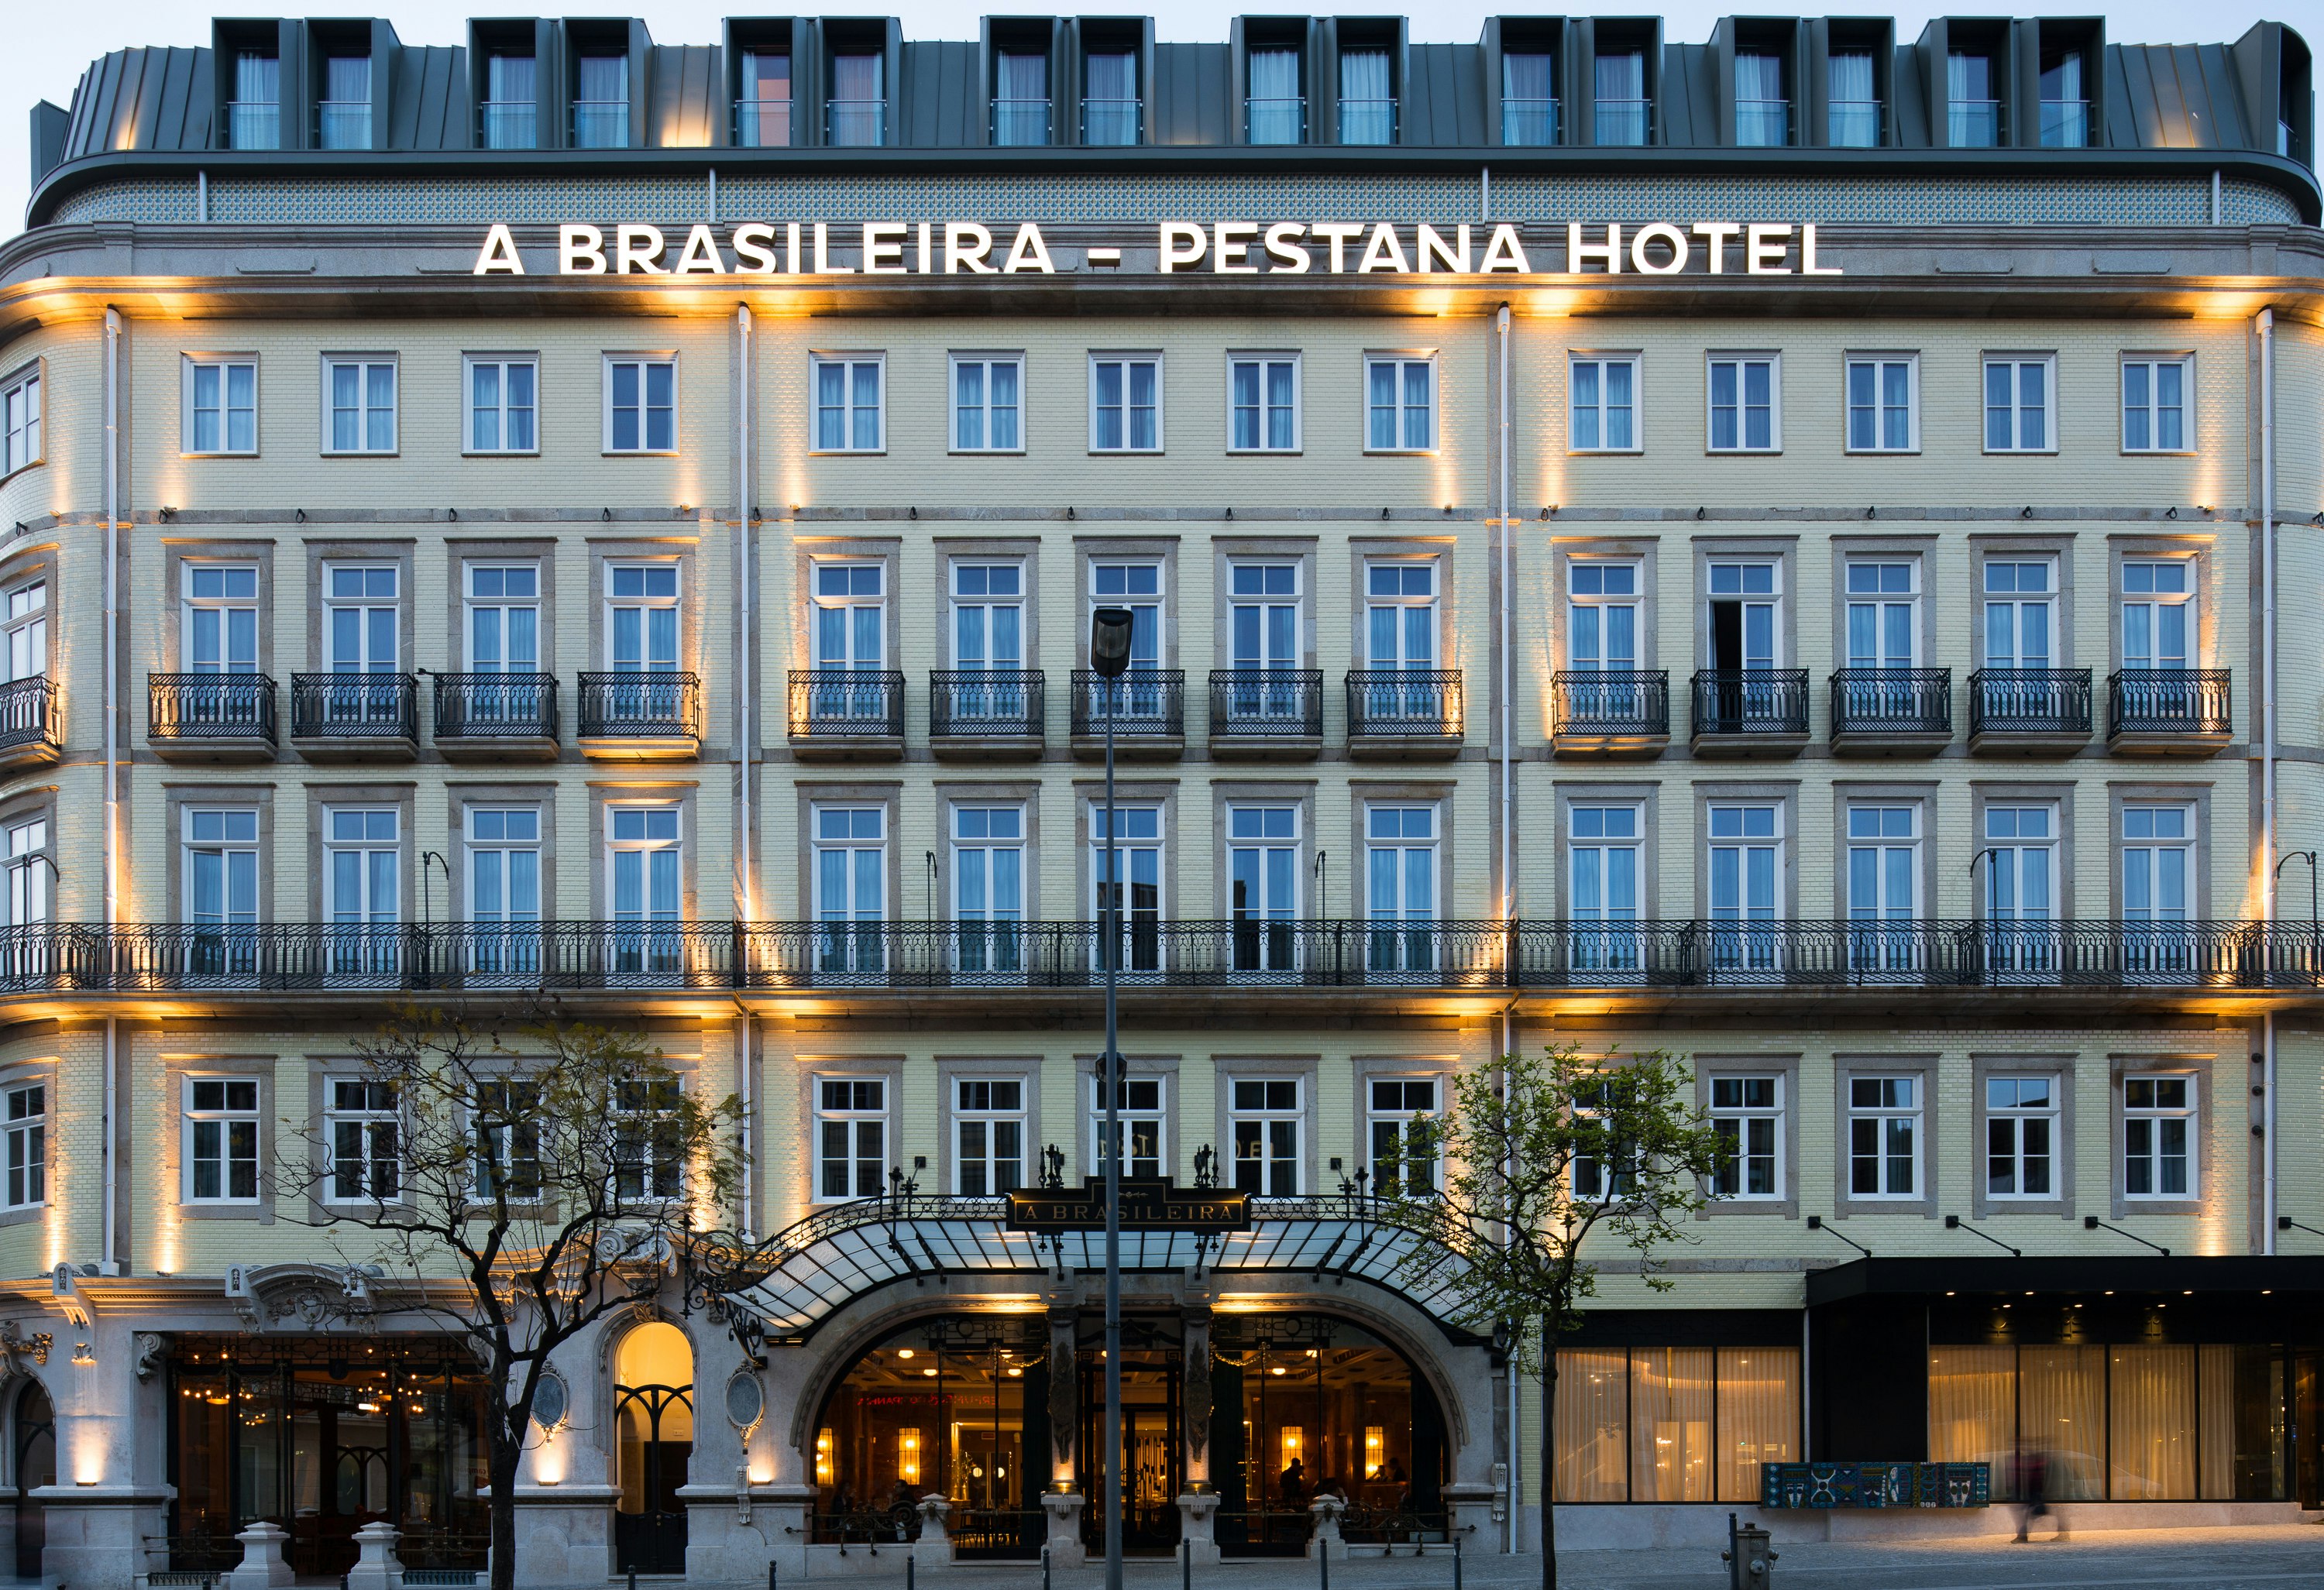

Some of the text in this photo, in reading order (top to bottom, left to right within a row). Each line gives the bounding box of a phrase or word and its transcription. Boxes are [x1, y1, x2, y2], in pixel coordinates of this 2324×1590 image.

[473, 223, 524, 274] A
[559, 222, 1056, 274] BRASILEIRA
[1160, 222, 1532, 274] PESTANA
[1568, 222, 1844, 275] HOTEL
[1023, 1205, 1233, 1220] A BRASILEIRA
